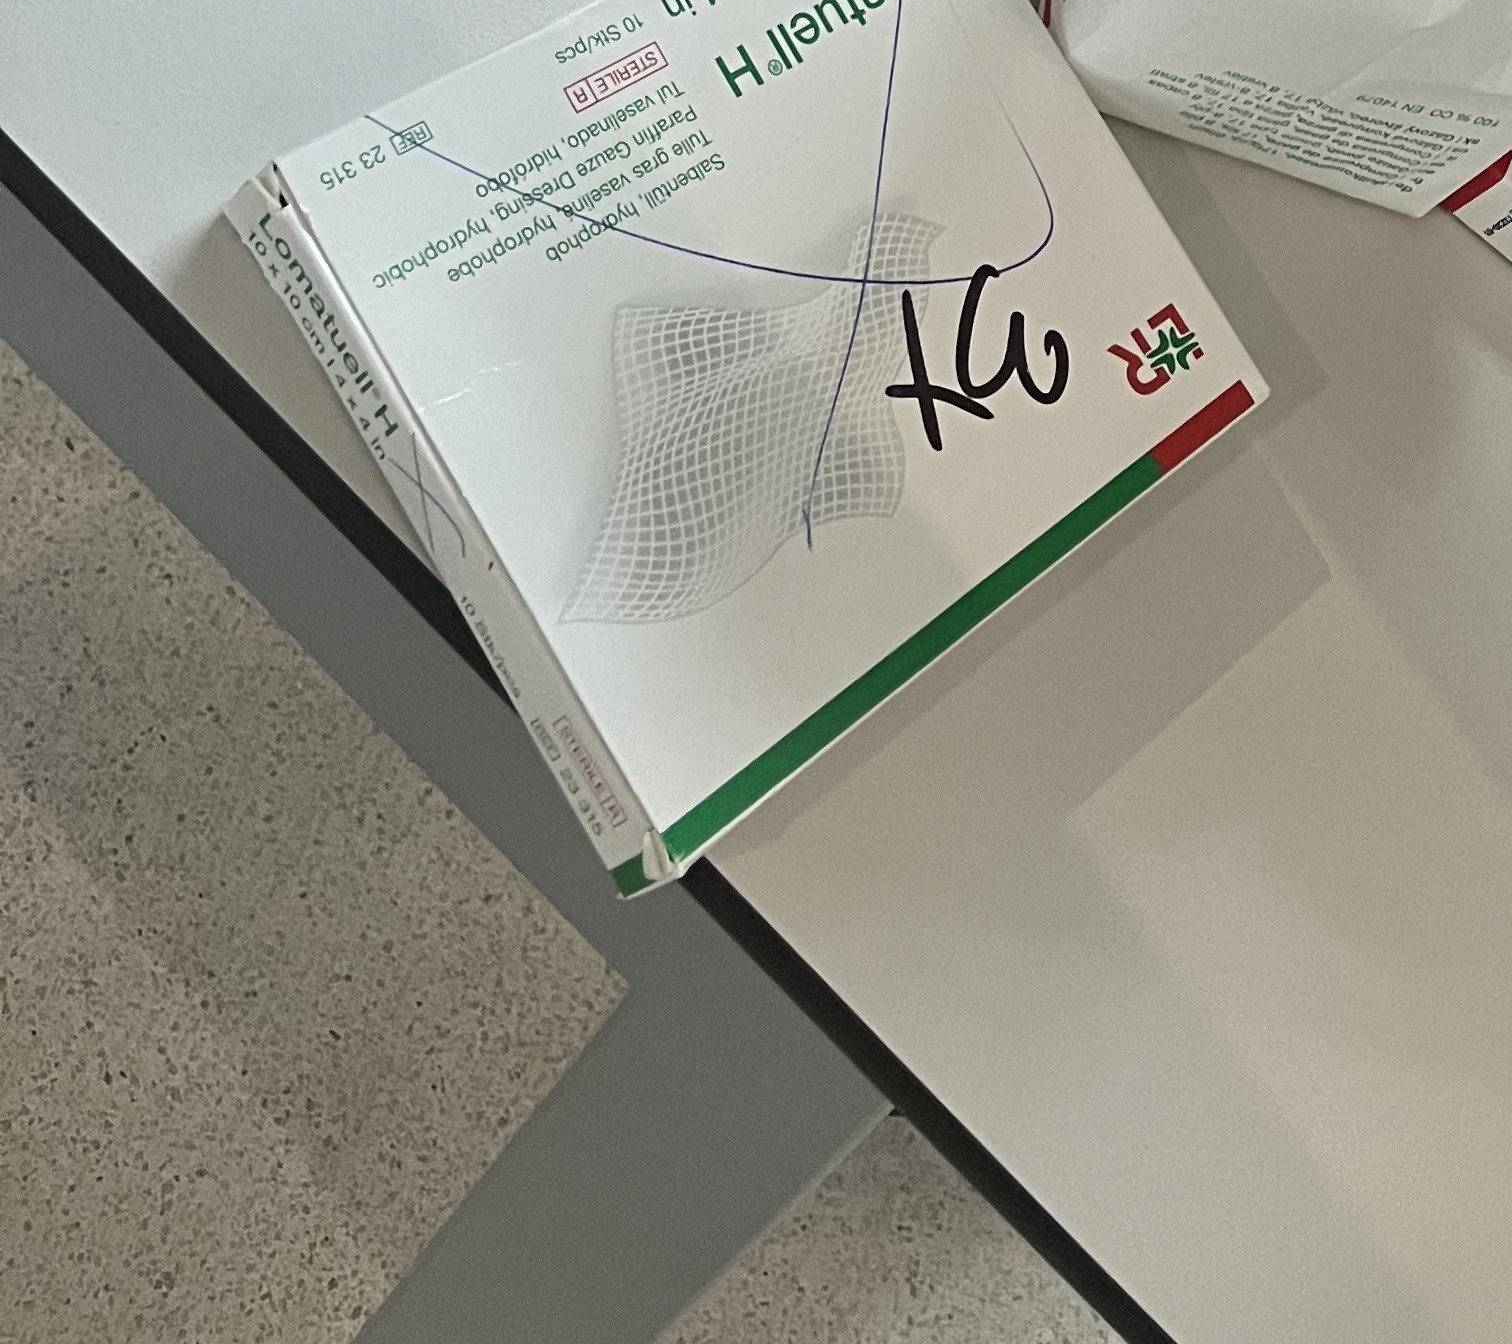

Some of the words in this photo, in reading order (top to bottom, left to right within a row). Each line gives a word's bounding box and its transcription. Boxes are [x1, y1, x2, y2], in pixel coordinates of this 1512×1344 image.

[552, 19, 623, 68] Stk/pcs
[620, 10, 645, 34] 10
[592, 48, 660, 94] STERILE
[654, 79, 685, 106] Tul
[713, 41, 764, 98] H
[572, 85, 590, 104] R
[395, 125, 428, 151] REF
[559, 92, 659, 156] vaselinado,
[630, 103, 699, 151] Paraffin
[669, 126, 714, 162] Tulle
[318, 159, 359, 191] 315
[357, 144, 387, 171] 23
[471, 142, 565, 204] hidrófobo
[574, 139, 633, 181] Gauze
[629, 147, 672, 181] gras
[487, 166, 578, 227] Dressing,
[637, 150, 727, 212] Salbentüll,
[369, 212, 492, 295] hydrophobic
[443, 210, 560, 288] hydrophobe
[543, 196, 641, 265] hydrophob
[246, 230, 270, 258] 10
[267, 261, 281, 277] x
[278, 283, 305, 312] 10
[296, 315, 329, 354] cm
[332, 371, 348, 388] 4
[344, 395, 359, 410] x
[355, 413, 374, 433] 4
[368, 436, 390, 462] in
[370, 404, 402, 437] H
[456, 593, 477, 617] 10
